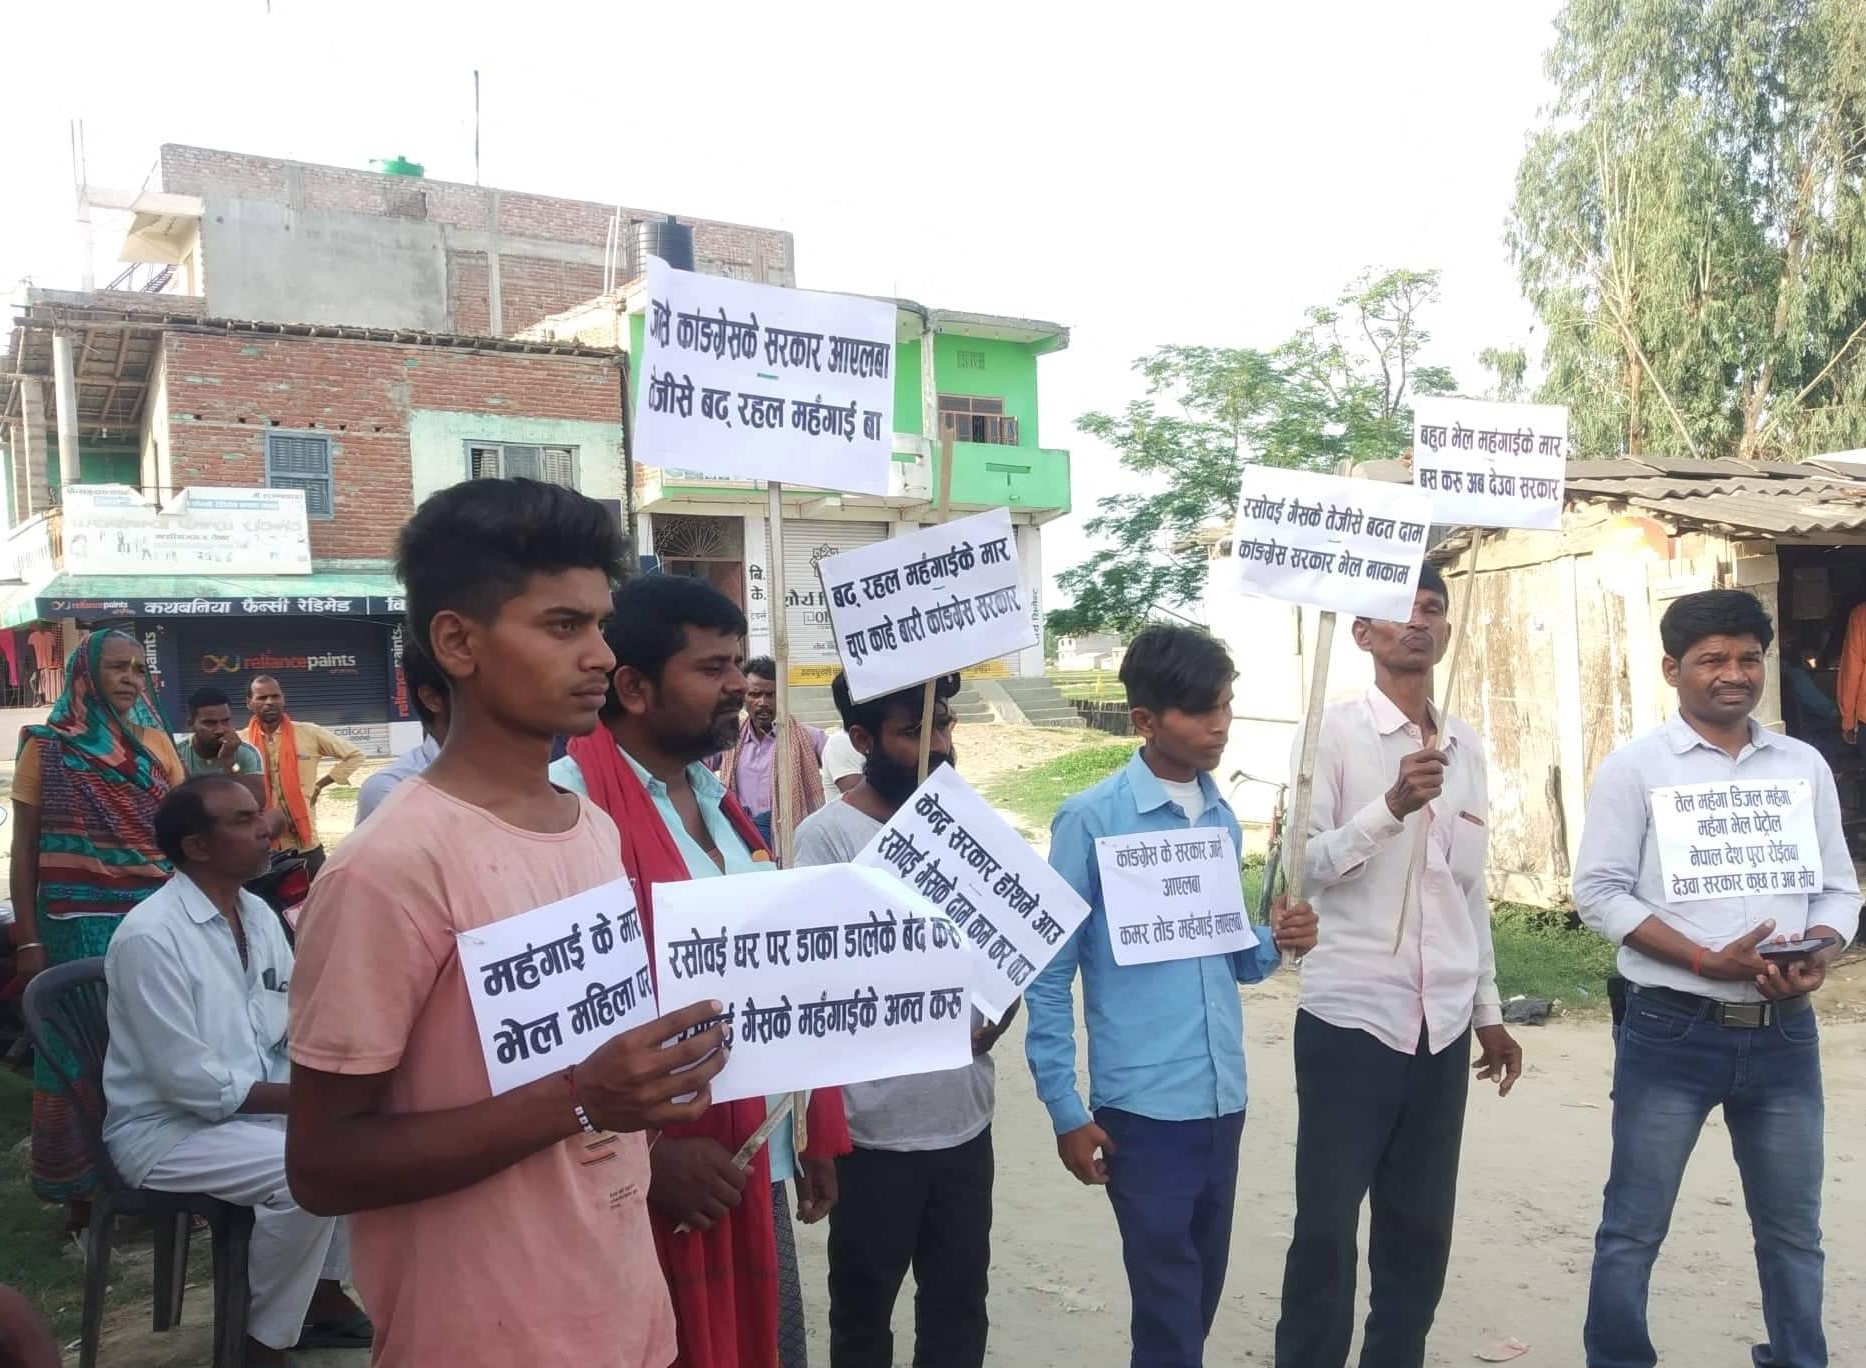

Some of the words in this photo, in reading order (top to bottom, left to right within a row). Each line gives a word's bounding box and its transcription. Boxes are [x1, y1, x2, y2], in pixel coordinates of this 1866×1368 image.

[764, 327, 823, 372] सरकार
[828, 336, 890, 379] आएलबा
[738, 392, 785, 428] रहल
[791, 394, 856, 442] महंगाई
[863, 411, 882, 441] बा
[1420, 425, 1447, 452] बहुत
[1452, 421, 1474, 450] भेल
[1478, 428, 1534, 456] महंगाईके
[1539, 435, 1563, 457] मार
[1420, 468, 1437, 489] बस
[1467, 472, 1485, 494] अब
[1489, 467, 1515, 496] देउवा
[1520, 477, 1559, 500] सरकार
[1244, 494, 1285, 525] रसोवई
[1288, 498, 1323, 526] गैसके
[1325, 505, 1364, 534] तेजीसे
[1366, 517, 1396, 539] बढत
[1398, 521, 1425, 543] दाम
[860, 569, 901, 600] रहल
[904, 541, 975, 586] महंगाईके
[979, 537, 1010, 564] मार
[1291, 547, 1336, 573] सरकार
[1338, 550, 1363, 577] भेल
[1366, 560, 1410, 584] नाकाम
[297, 597, 352, 613] रेडिमेड
[845, 630, 868, 665] चुप
[867, 615, 897, 652] काहे
[897, 607, 925, 644] बारी
[975, 585, 1021, 621] सरकार
[1674, 791, 1694, 812] तेल
[1697, 788, 1728, 811] महंगा
[1730, 785, 1763, 807] डिजल
[1697, 814, 1728, 837] महंगा
[1731, 812, 1751, 834] भेल
[1754, 810, 1782, 836] पेट्रोल
[915, 793, 954, 836] केन्द्र
[949, 826, 1002, 883] सरकार
[993, 872, 1040, 920] होशमे
[1032, 910, 1065, 946] आउ
[1161, 839, 1172, 863] के
[1175, 841, 1207, 863] सरकार
[1689, 845, 1722, 867] नेपाल
[1725, 842, 1743, 864] देश
[1745, 845, 1765, 868] पुरा
[877, 828, 928, 878] रसोवई
[915, 858, 958, 901] गैसके
[945, 893, 976, 928] दाम
[967, 914, 997, 948] कम
[1162, 875, 1201, 896] आएलबा
[1672, 874, 1699, 896] देउवा
[1702, 874, 1743, 894] सरकार
[1746, 872, 1767, 893] कुछ
[1770, 872, 1778, 889] त
[1782, 871, 1795, 888] अब
[1798, 865, 1815, 888] सोच
[668, 926, 728, 979] रसोवई
[734, 931, 760, 969] घर
[766, 930, 790, 966] पर
[796, 925, 838, 962] डाका
[844, 910, 897, 957] डालेके
[1119, 923, 1149, 945] कमर
[1153, 915, 1174, 942] तोड
[1178, 910, 1213, 939] महंगाई
[480, 923, 585, 996] महंगाई
[589, 913, 613, 954] के
[617, 907, 641, 943] मार
[493, 1012, 563, 1064] भेल
[567, 977, 636, 1035] महिला
[636, 964, 652, 997] पर
[742, 996, 792, 1044] गैसके
[798, 986, 877, 1039] महंगाईके
[884, 991, 925, 1026] अन्त
